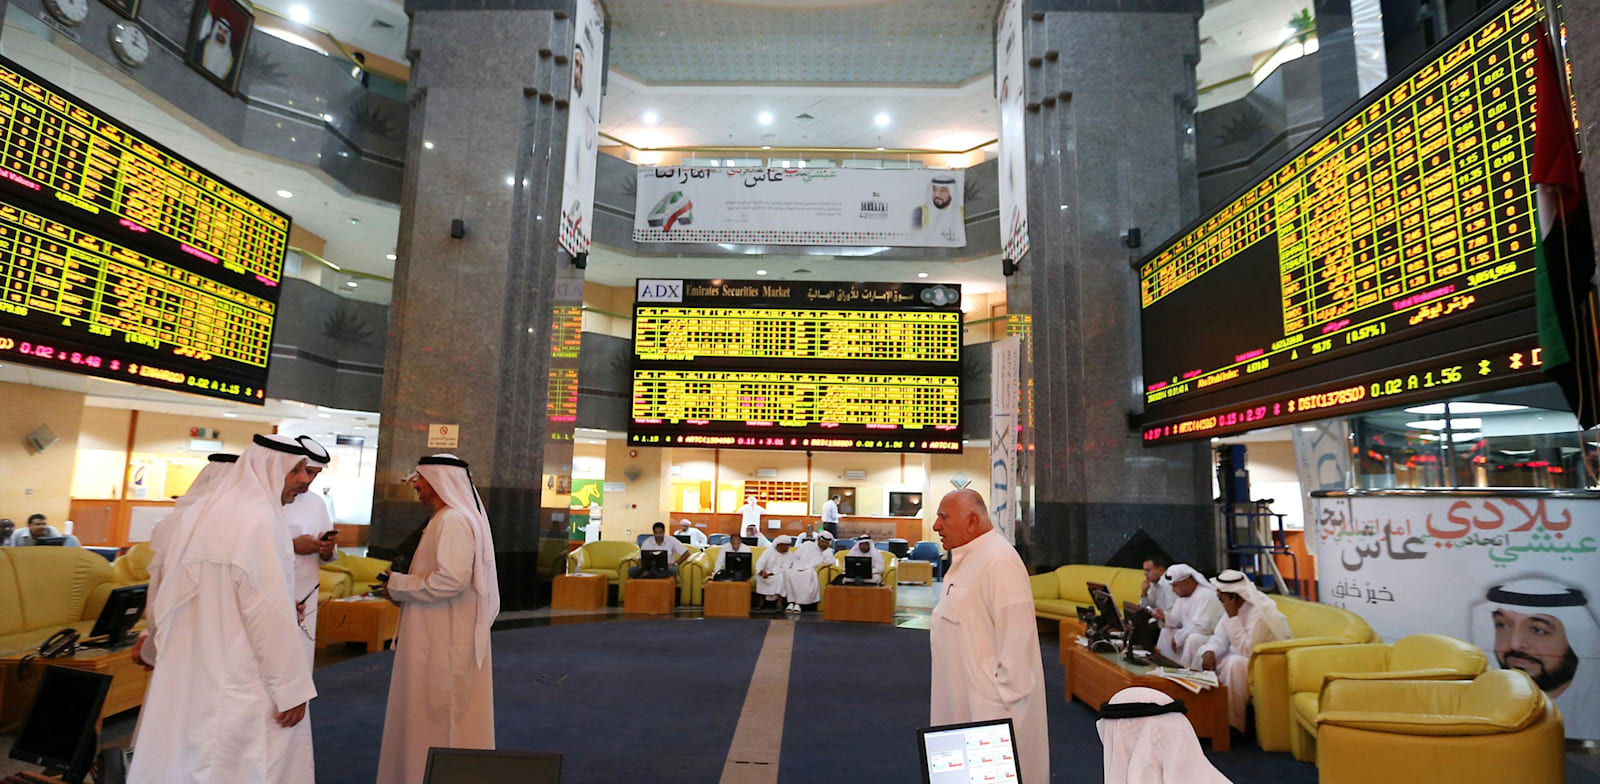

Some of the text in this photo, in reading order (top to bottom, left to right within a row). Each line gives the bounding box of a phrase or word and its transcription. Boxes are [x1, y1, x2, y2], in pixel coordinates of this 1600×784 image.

[641, 284, 680, 298] ADX
[686, 284, 791, 298] Emirates Securities Market
[19, 341, 54, 359] 0.02
[1370, 379, 1403, 398] 0.02
[1423, 365, 1463, 388] 1.56
